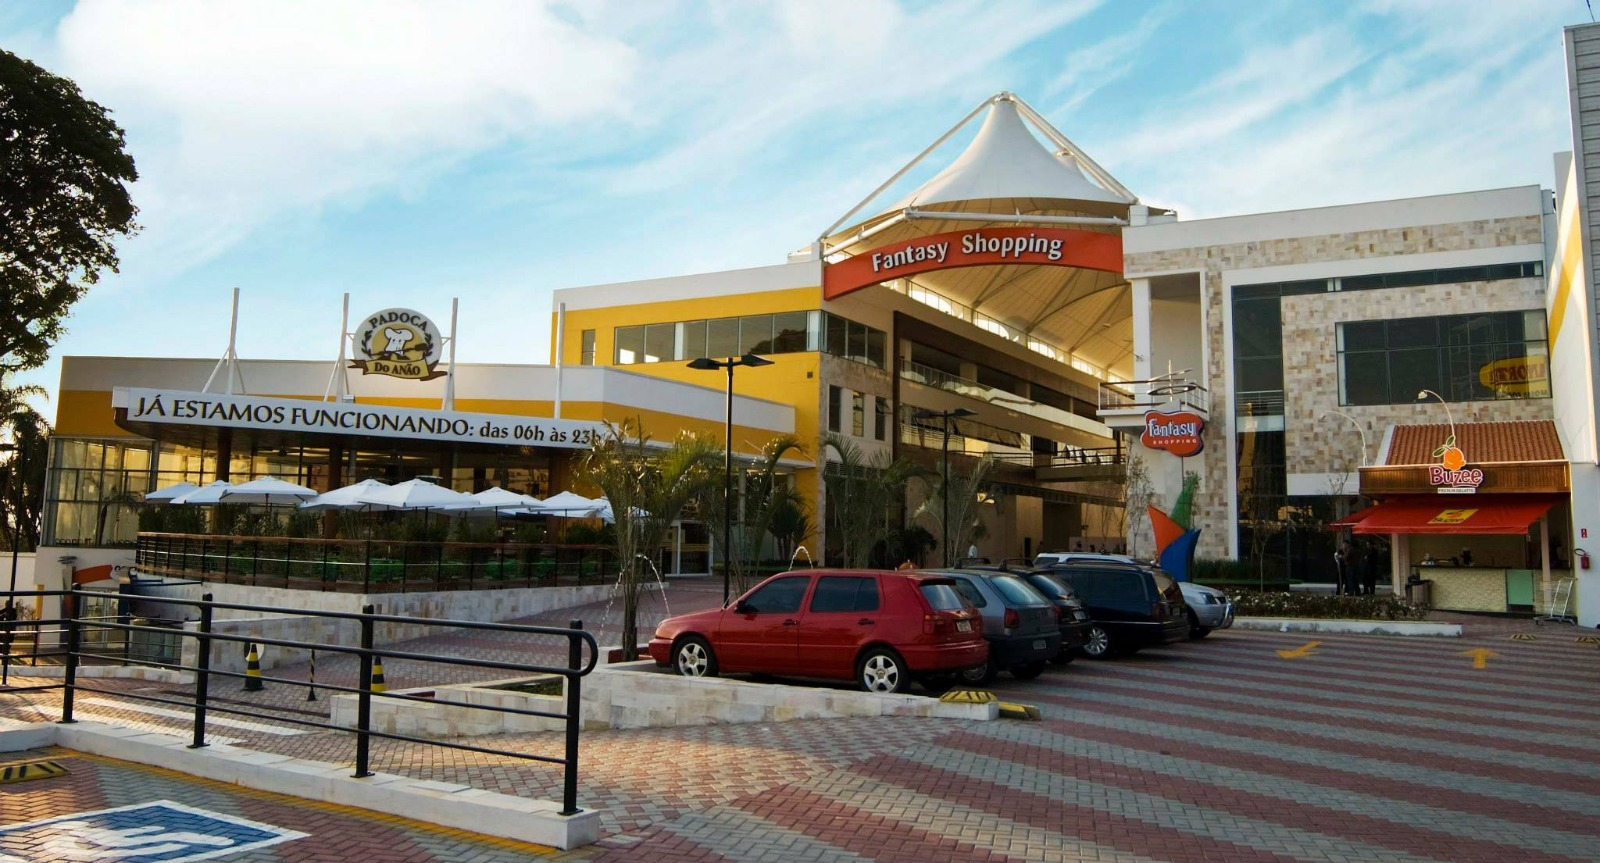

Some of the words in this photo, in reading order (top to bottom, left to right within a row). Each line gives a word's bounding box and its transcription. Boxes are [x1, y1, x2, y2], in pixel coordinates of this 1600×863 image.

[872, 241, 949, 272] Fantasy
[961, 232, 1063, 260] Shopping
[368, 311, 428, 332] PADOCA
[374, 362, 390, 372] Do
[391, 363, 420, 376] ANÃO
[133, 394, 166, 418] JÁ
[172, 399, 285, 424] ESTAMOS
[290, 407, 475, 436] FUNCIONANDO:
[479, 421, 509, 439] das
[513, 424, 545, 442] 06h
[550, 427, 567, 443] às
[1429, 466, 1484, 487] Buzee
